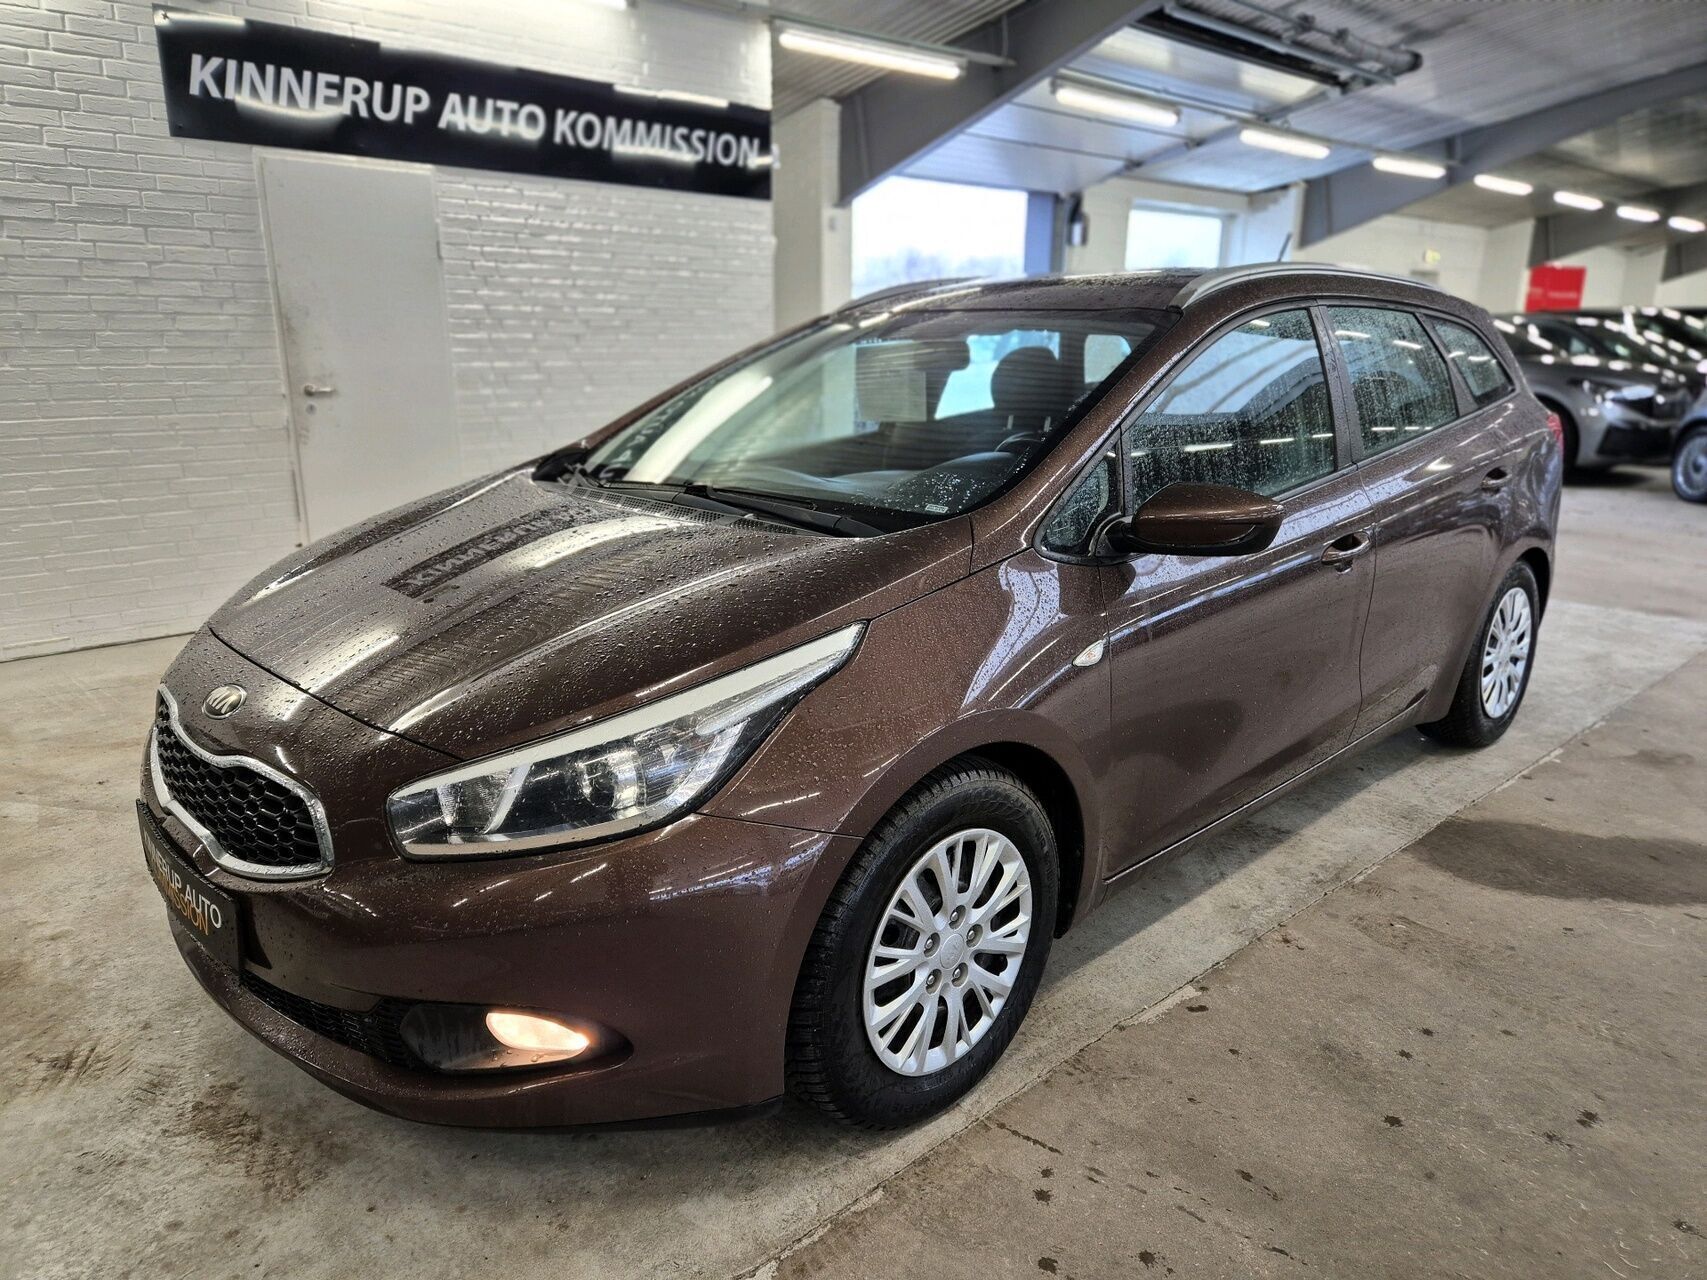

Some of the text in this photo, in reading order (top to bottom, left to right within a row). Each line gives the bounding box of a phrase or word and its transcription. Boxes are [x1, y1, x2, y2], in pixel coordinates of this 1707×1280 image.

[189, 53, 430, 125] KINNERUP
[438, 92, 547, 141] AUTO
[553, 108, 760, 169] KOMMISSION
[185, 884, 222, 929] AUTO
